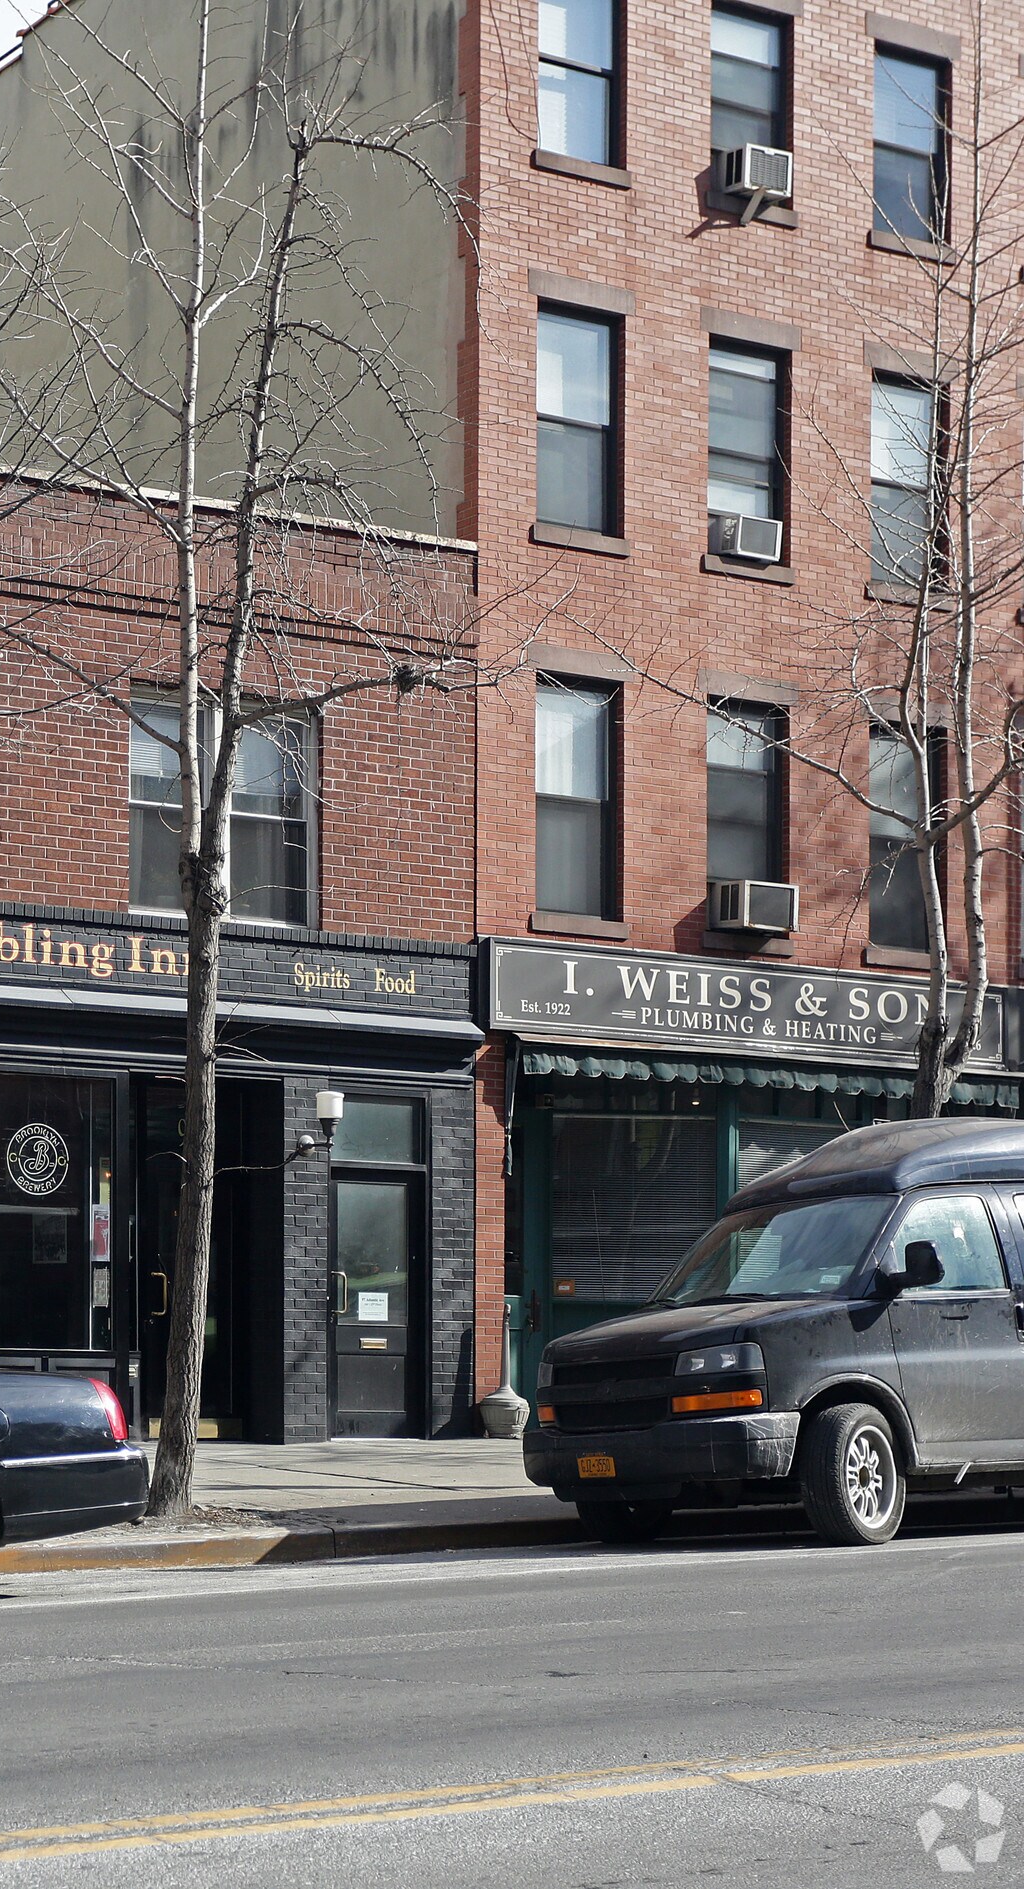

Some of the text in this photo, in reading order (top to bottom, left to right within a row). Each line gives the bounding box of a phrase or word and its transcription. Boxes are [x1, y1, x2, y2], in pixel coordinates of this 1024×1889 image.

[294, 962, 416, 994] Spirits Food
[562, 960, 595, 997] I.
[617, 965, 772, 1012] WEISS
[794, 982, 828, 1017] &
[521, 1000, 571, 1016] Est. 1922
[640, 1006, 877, 1044] PLUMBING & HEATING
[15, 1126, 61, 1147] BROOKLYN
[16, 1175, 57, 1193] BREWERY
